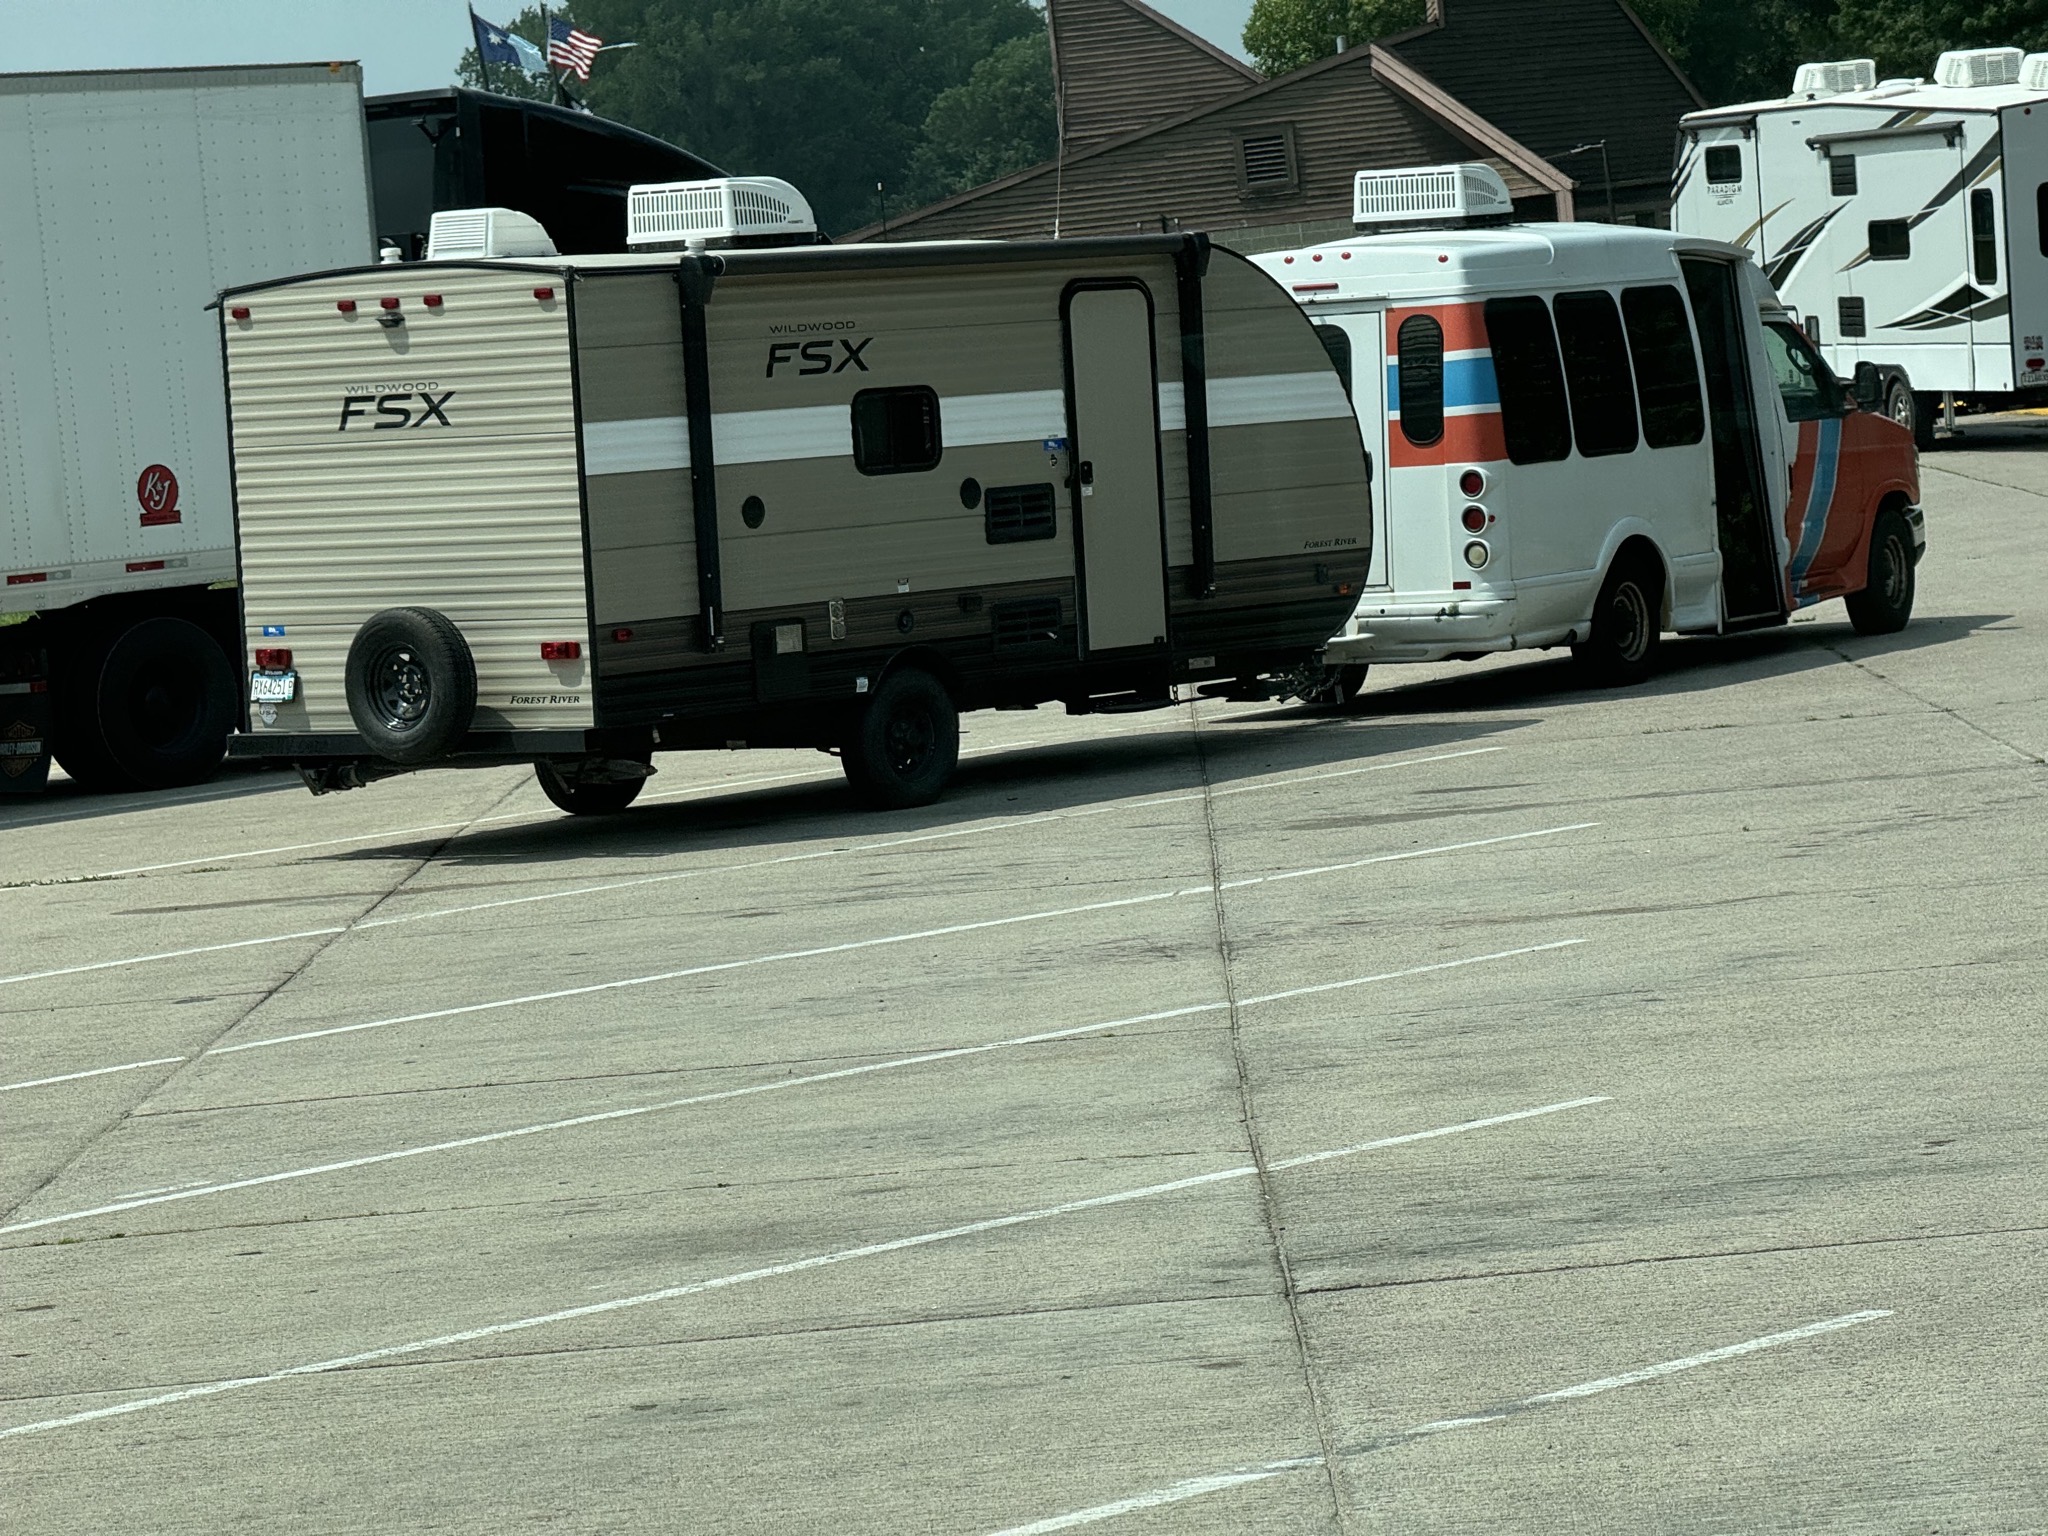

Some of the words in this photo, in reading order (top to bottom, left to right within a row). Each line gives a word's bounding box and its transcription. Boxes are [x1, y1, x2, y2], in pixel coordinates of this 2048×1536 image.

[1707, 184, 1742, 194] PARADIGM
[769, 321, 856, 334] WILDWOOD
[766, 337, 874, 378] FSX
[345, 382, 439, 394] WILDWOOD
[338, 391, 456, 431] FSX
[1303, 540, 1333, 549] FOREST
[1334, 537, 1357, 546] RIVER
[253, 679, 286, 696] RX64251
[510, 695, 548, 704] FOREST
[549, 695, 580, 704] RIVER
